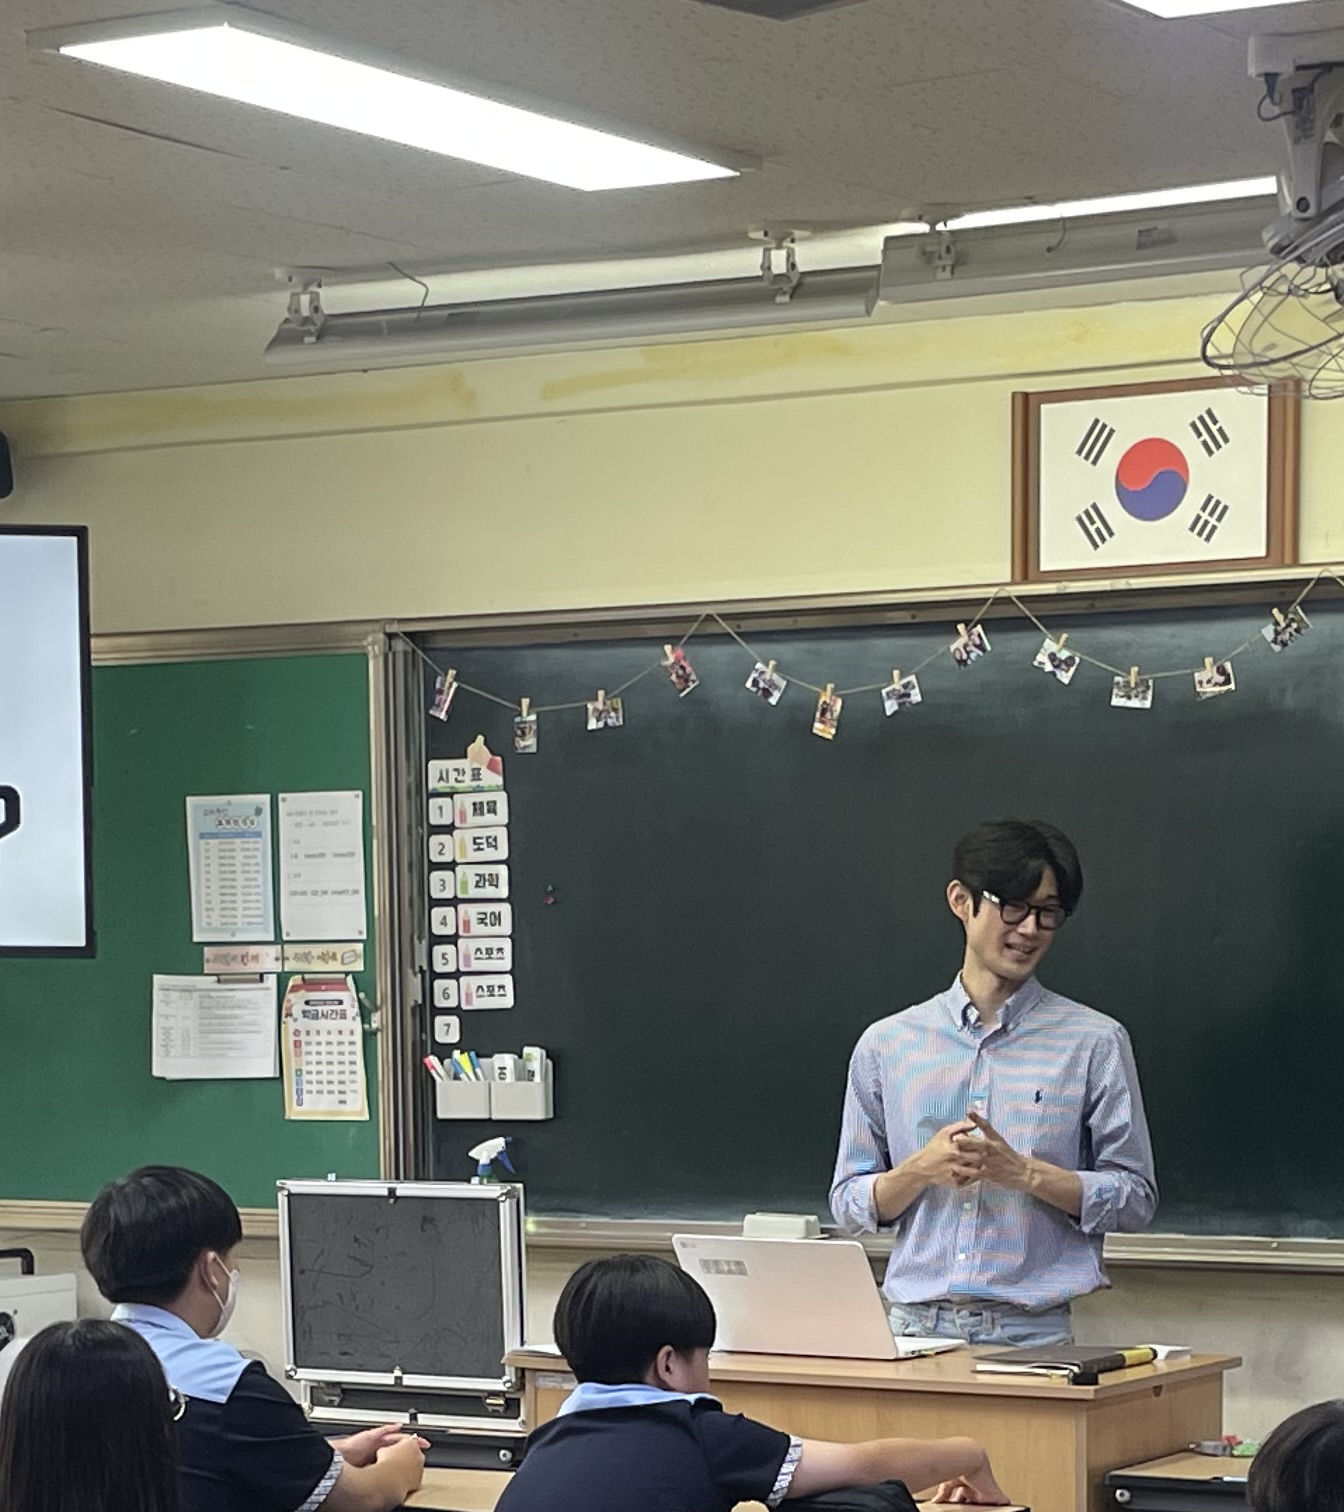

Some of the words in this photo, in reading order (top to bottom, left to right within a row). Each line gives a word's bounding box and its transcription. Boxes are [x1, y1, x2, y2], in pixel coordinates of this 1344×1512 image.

[437, 767, 483, 783] 시간표
[438, 805, 443, 819] 1
[438, 842, 445, 856] 2
[473, 836, 498, 852] 도덕
[439, 878, 446, 892] 3
[440, 915, 447, 928] 4
[476, 911, 502, 927] 국어
[441, 953, 449, 966] 5
[474, 947, 506, 960] 스포츠
[442, 987, 450, 1001] 6
[476, 985, 507, 998] 스포츠
[443, 1023, 451, 1036] 7
